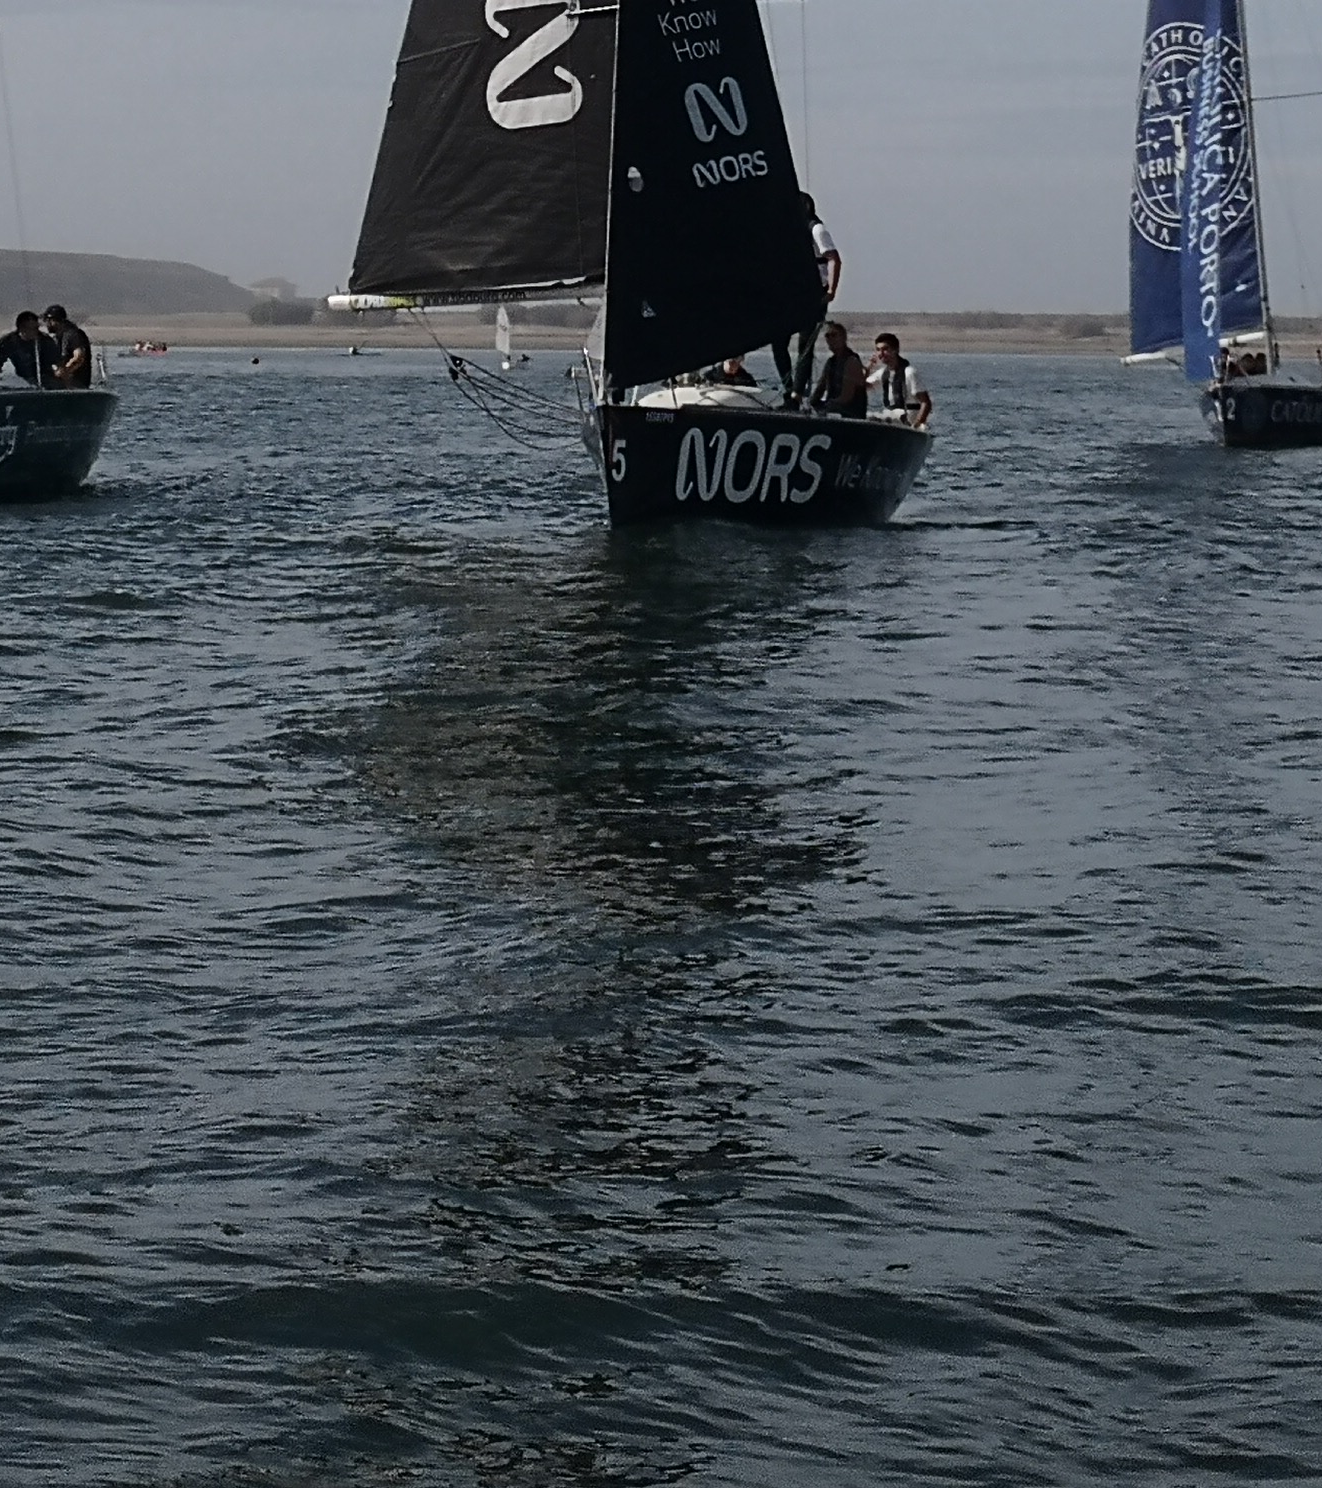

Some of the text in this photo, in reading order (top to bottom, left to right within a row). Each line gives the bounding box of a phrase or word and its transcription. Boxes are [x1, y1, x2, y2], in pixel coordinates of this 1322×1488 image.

[657, 9, 718, 37] Know
[672, 38, 721, 62] How
[692, 150, 768, 188] NORS
[611, 439, 627, 482] 5
[675, 427, 832, 504] NORS
